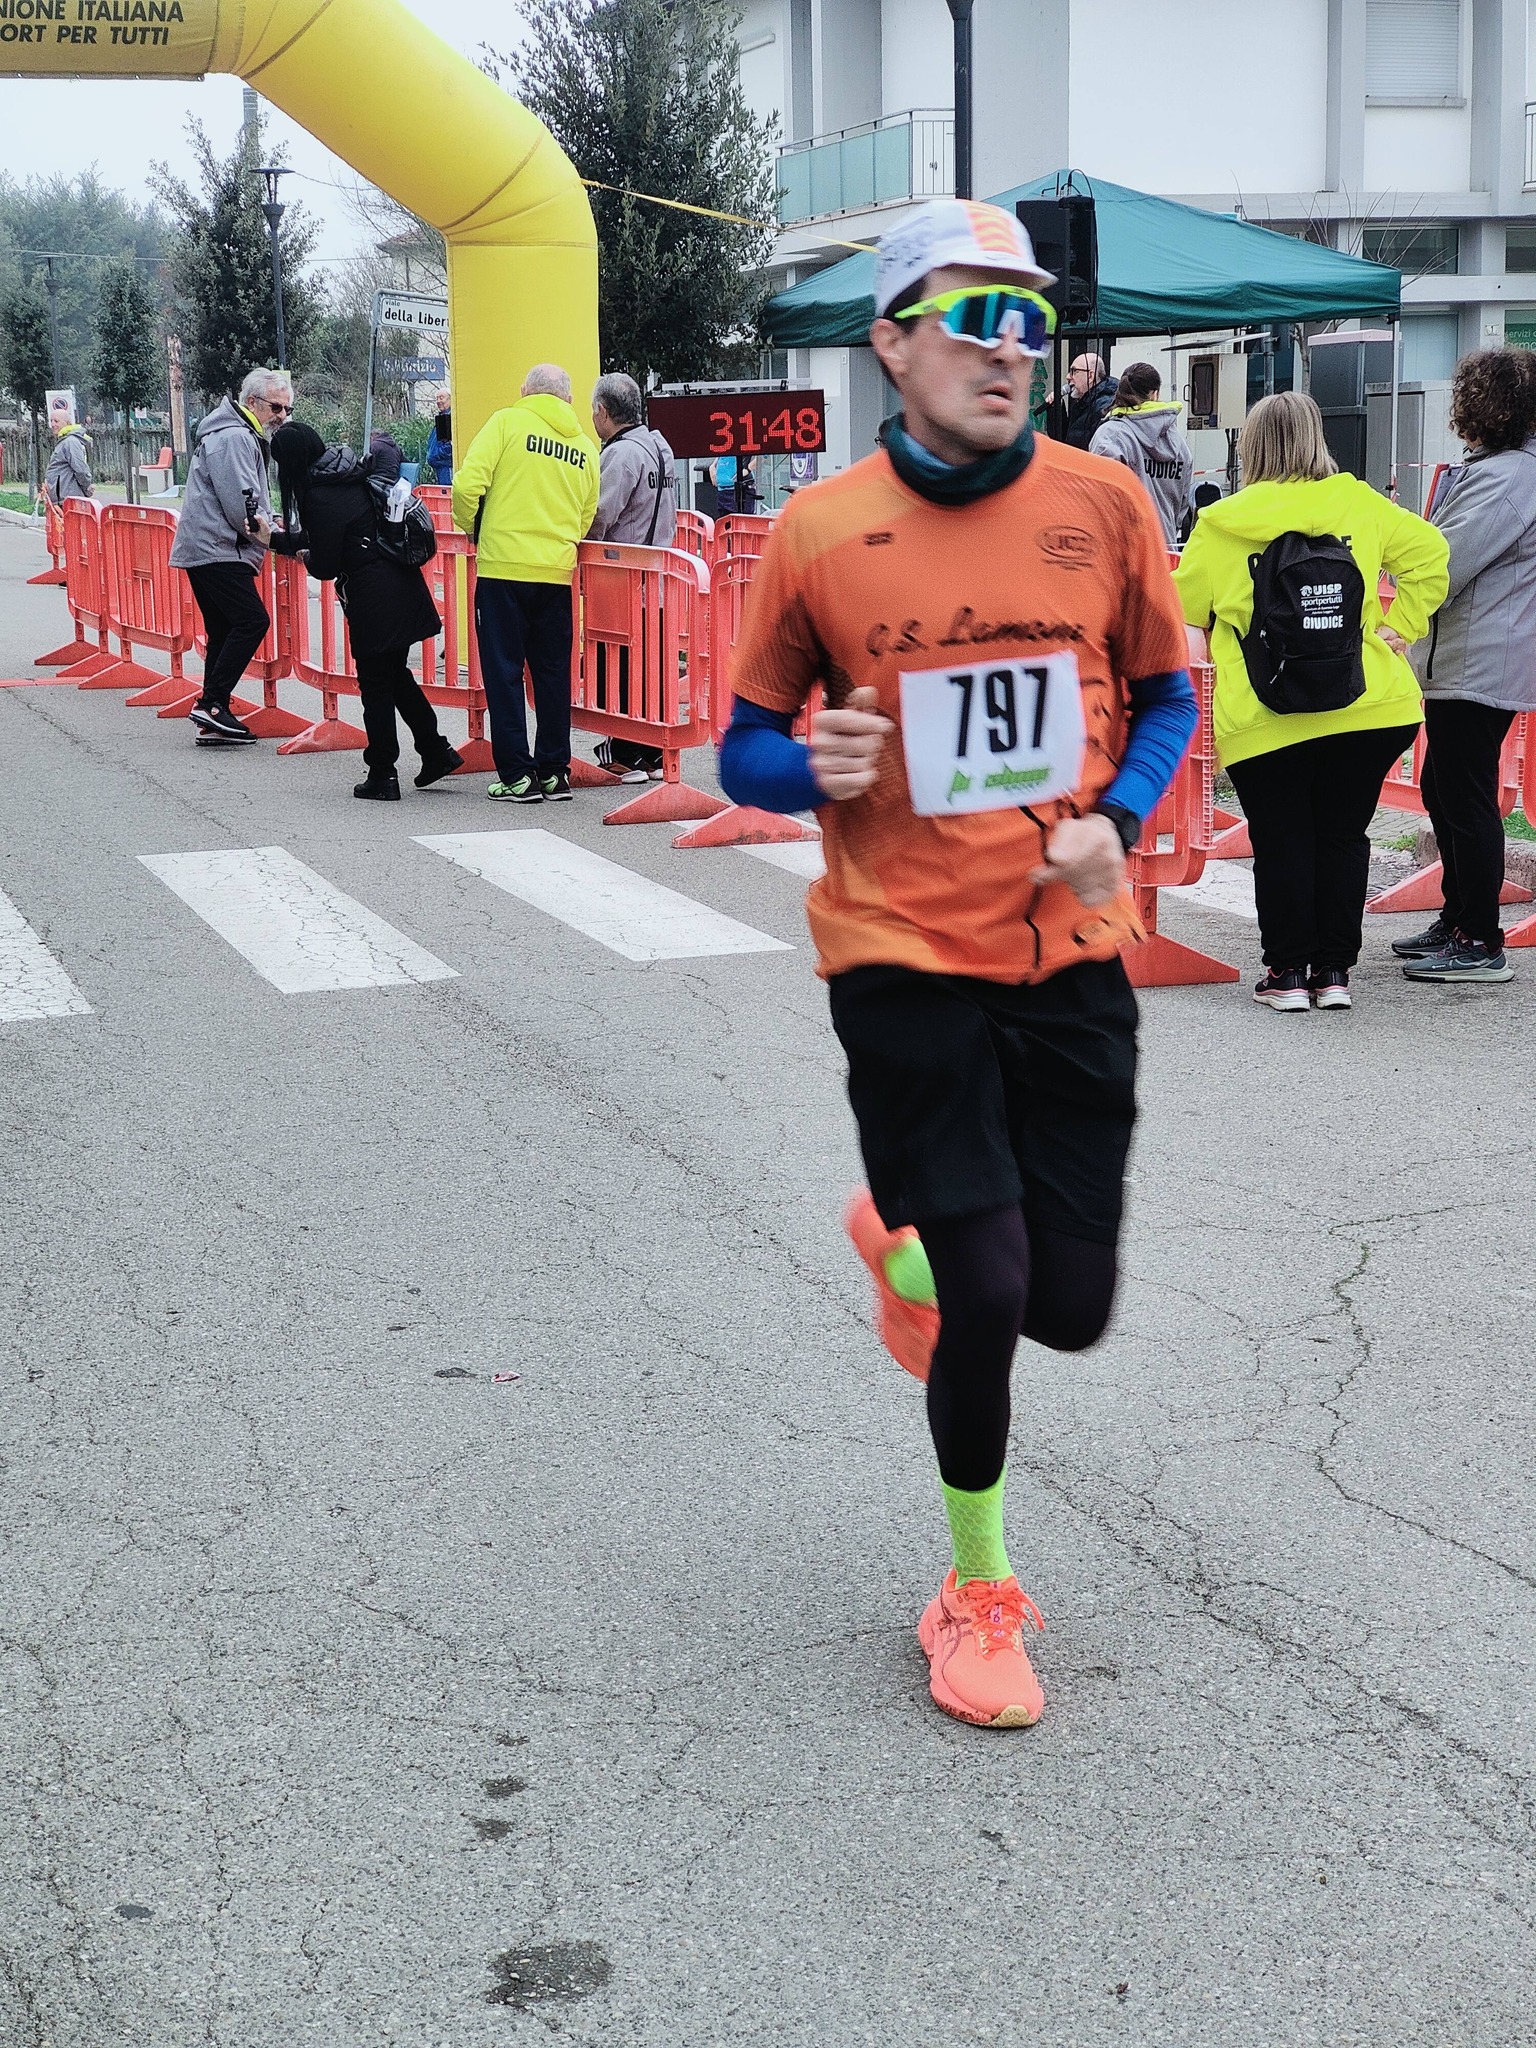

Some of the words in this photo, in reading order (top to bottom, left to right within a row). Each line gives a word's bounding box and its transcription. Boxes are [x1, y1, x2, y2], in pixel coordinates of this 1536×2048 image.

[78, 0, 184, 22] ITALIANA
[56, 25, 97, 44] PER
[110, 26, 169, 45] TUTTI
[384, 307, 413, 322] della
[709, 407, 822, 453] 31:48
[525, 434, 587, 470] GIUDICE
[1312, 583, 1343, 596] UISP
[1303, 615, 1343, 629] GIUDICE
[947, 666, 1048, 757] 797
